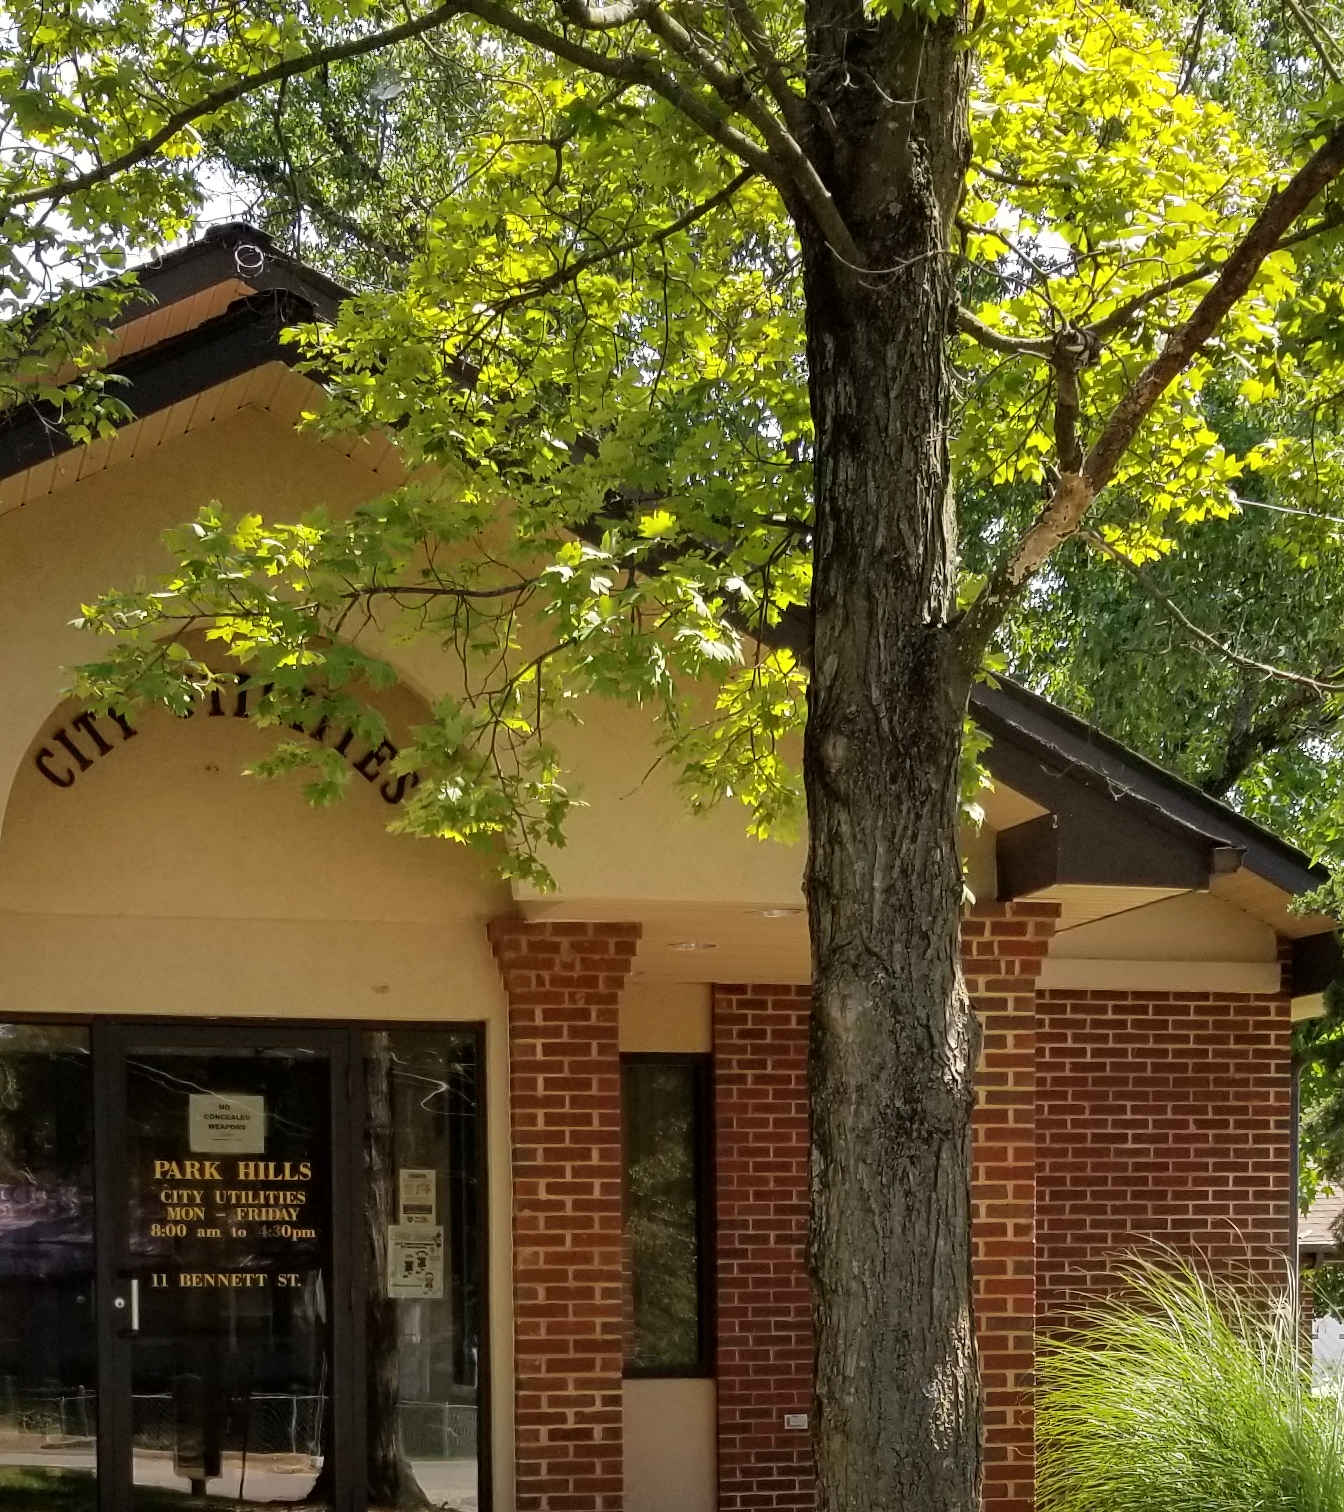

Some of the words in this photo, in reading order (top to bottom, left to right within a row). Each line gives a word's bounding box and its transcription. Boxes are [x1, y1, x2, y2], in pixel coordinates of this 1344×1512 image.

[203, 1113, 251, 1121] CONCEALED
[208, 1123, 247, 1131] WEAPONS
[154, 1160, 223, 1180] PARK
[237, 1161, 312, 1181] HILLS
[160, 1190, 205, 1204] CITY
[215, 1190, 306, 1205] UTILITIES
[167, 1207, 206, 1221] MON
[236, 1207, 300, 1222] FRIDAY
[150, 1223, 187, 1238] 8:00
[196, 1228, 222, 1238] am
[230, 1226, 247, 1238] to
[258, 1224, 317, 1242] 4:30pm
[151, 1273, 169, 1288] 11
[179, 1273, 268, 1288] BENNETT
[277, 1273, 302, 1288] ST.
